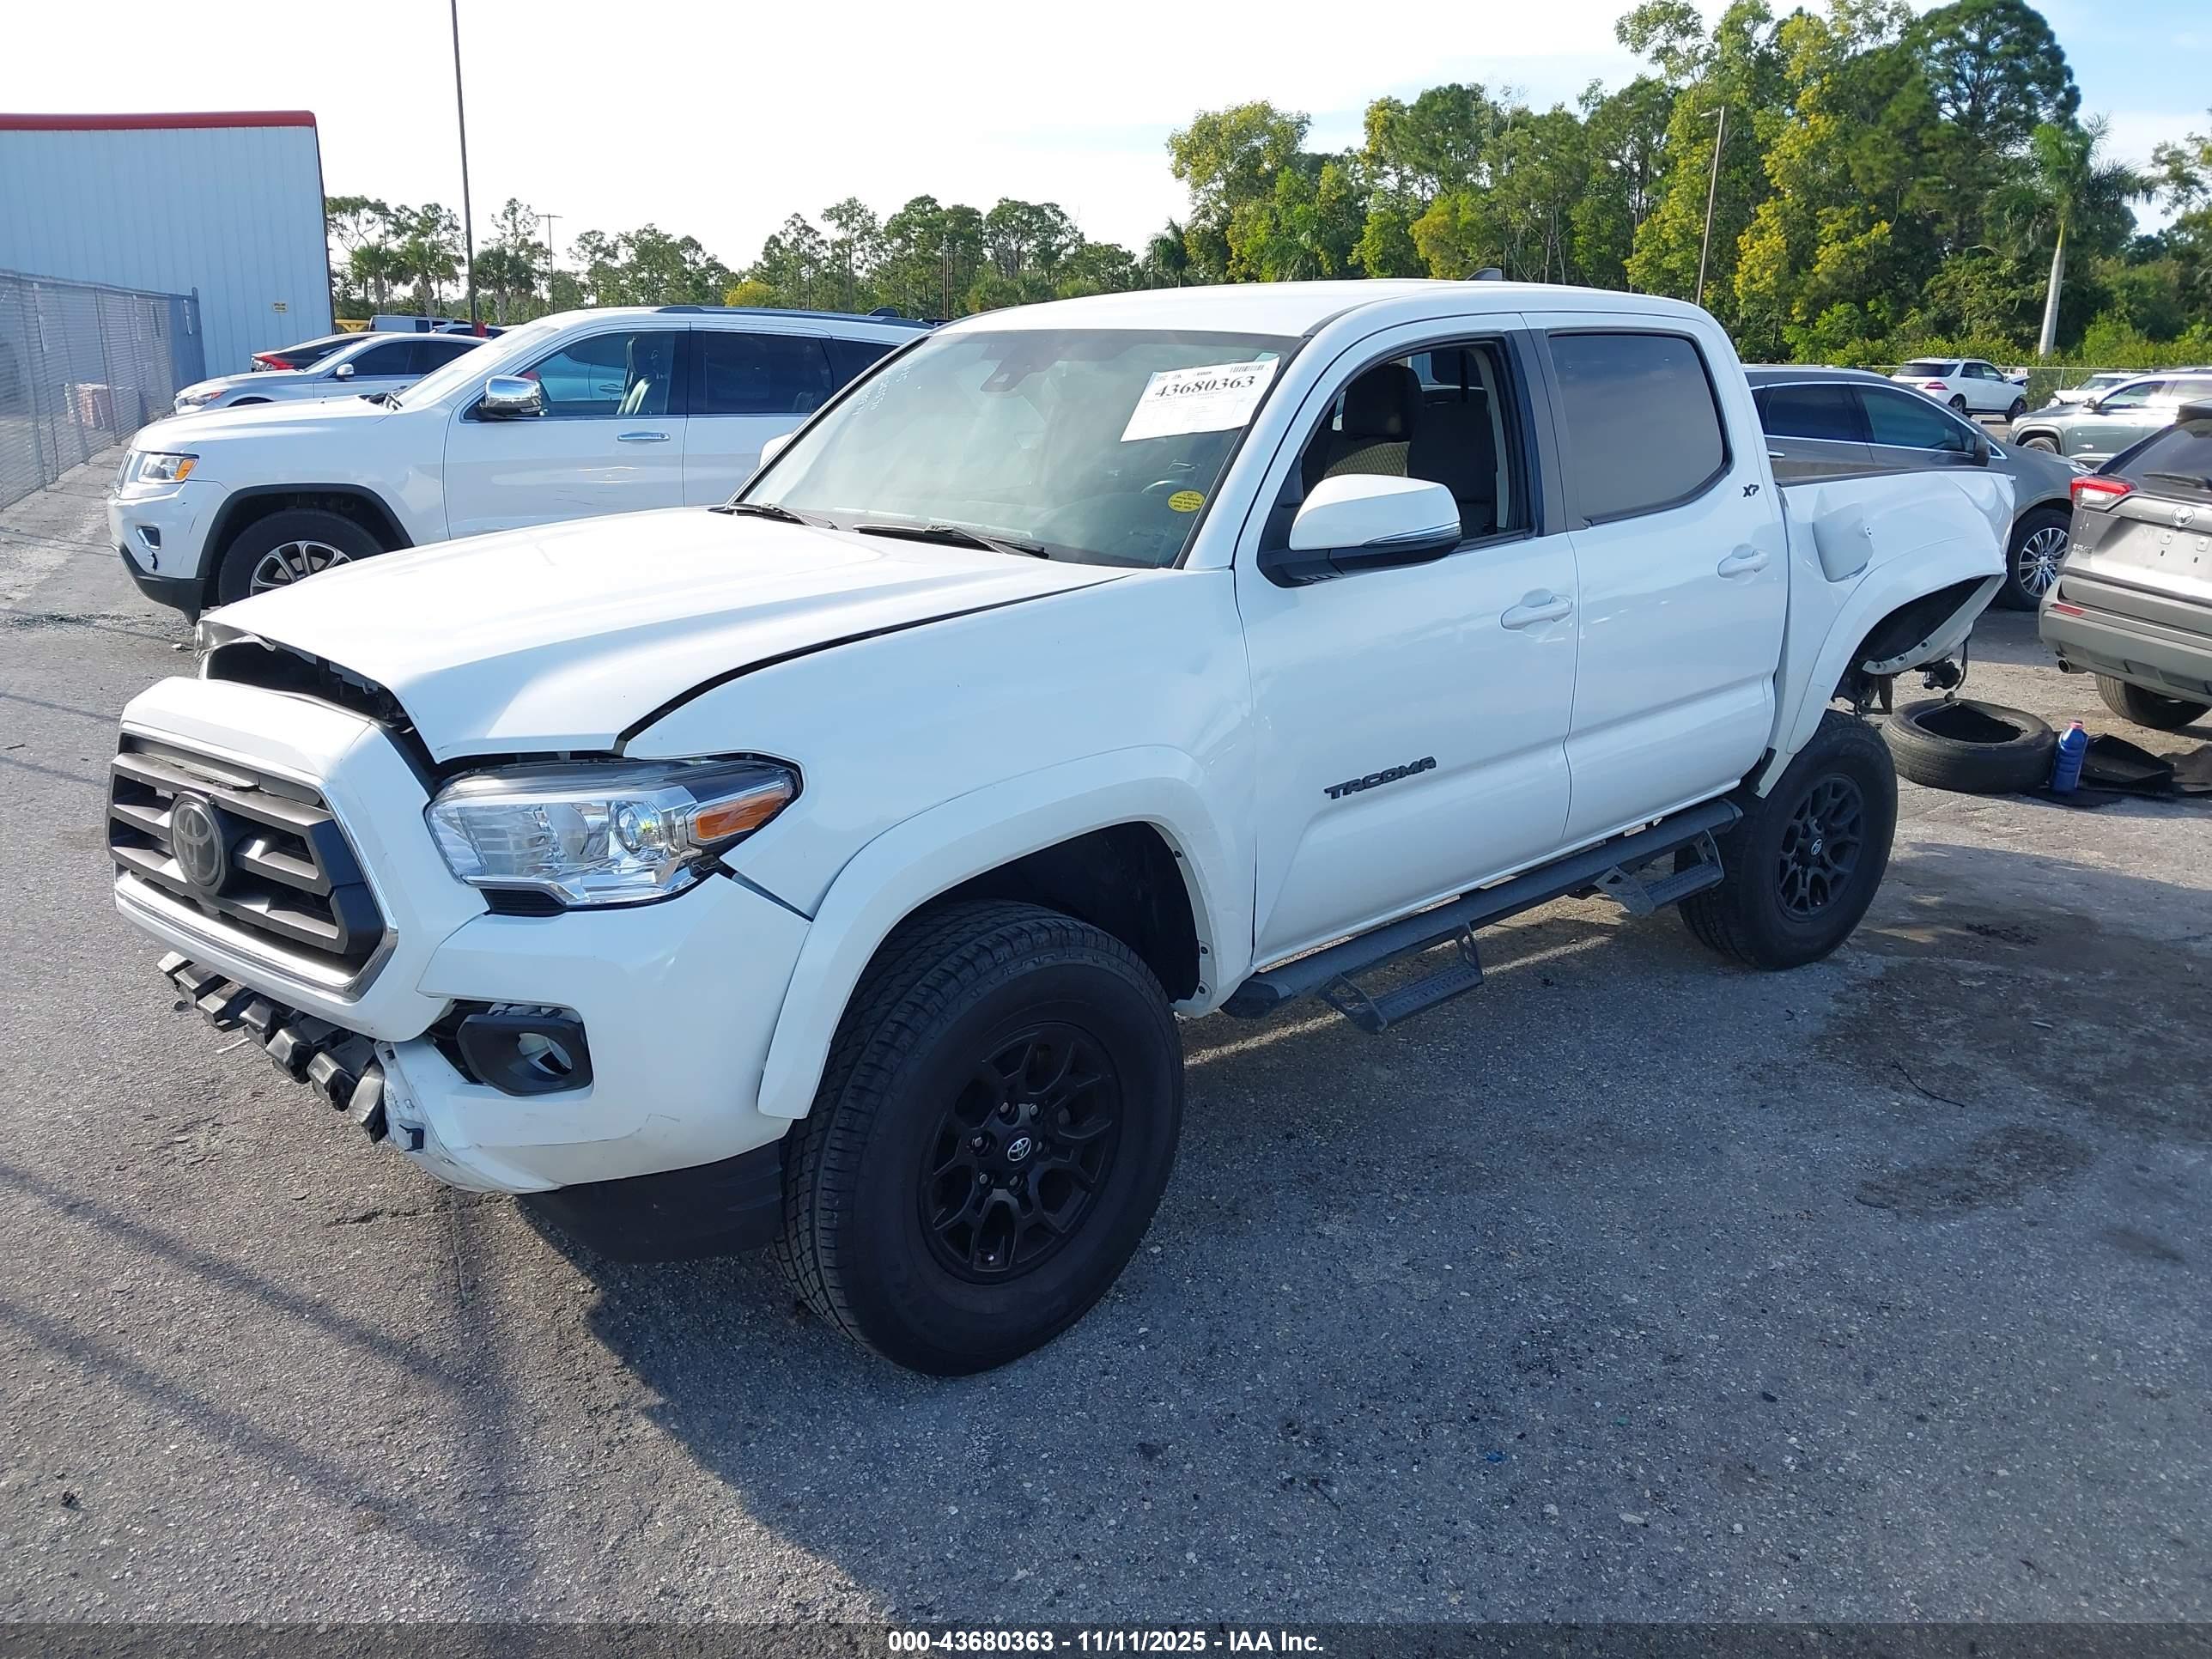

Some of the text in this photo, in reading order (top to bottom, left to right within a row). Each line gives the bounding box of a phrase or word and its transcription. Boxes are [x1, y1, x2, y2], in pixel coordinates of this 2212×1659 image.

[1155, 375, 1255, 397] 43680363
[1742, 483, 1760, 497] XP
[1323, 756, 1437, 799] TACOMA
